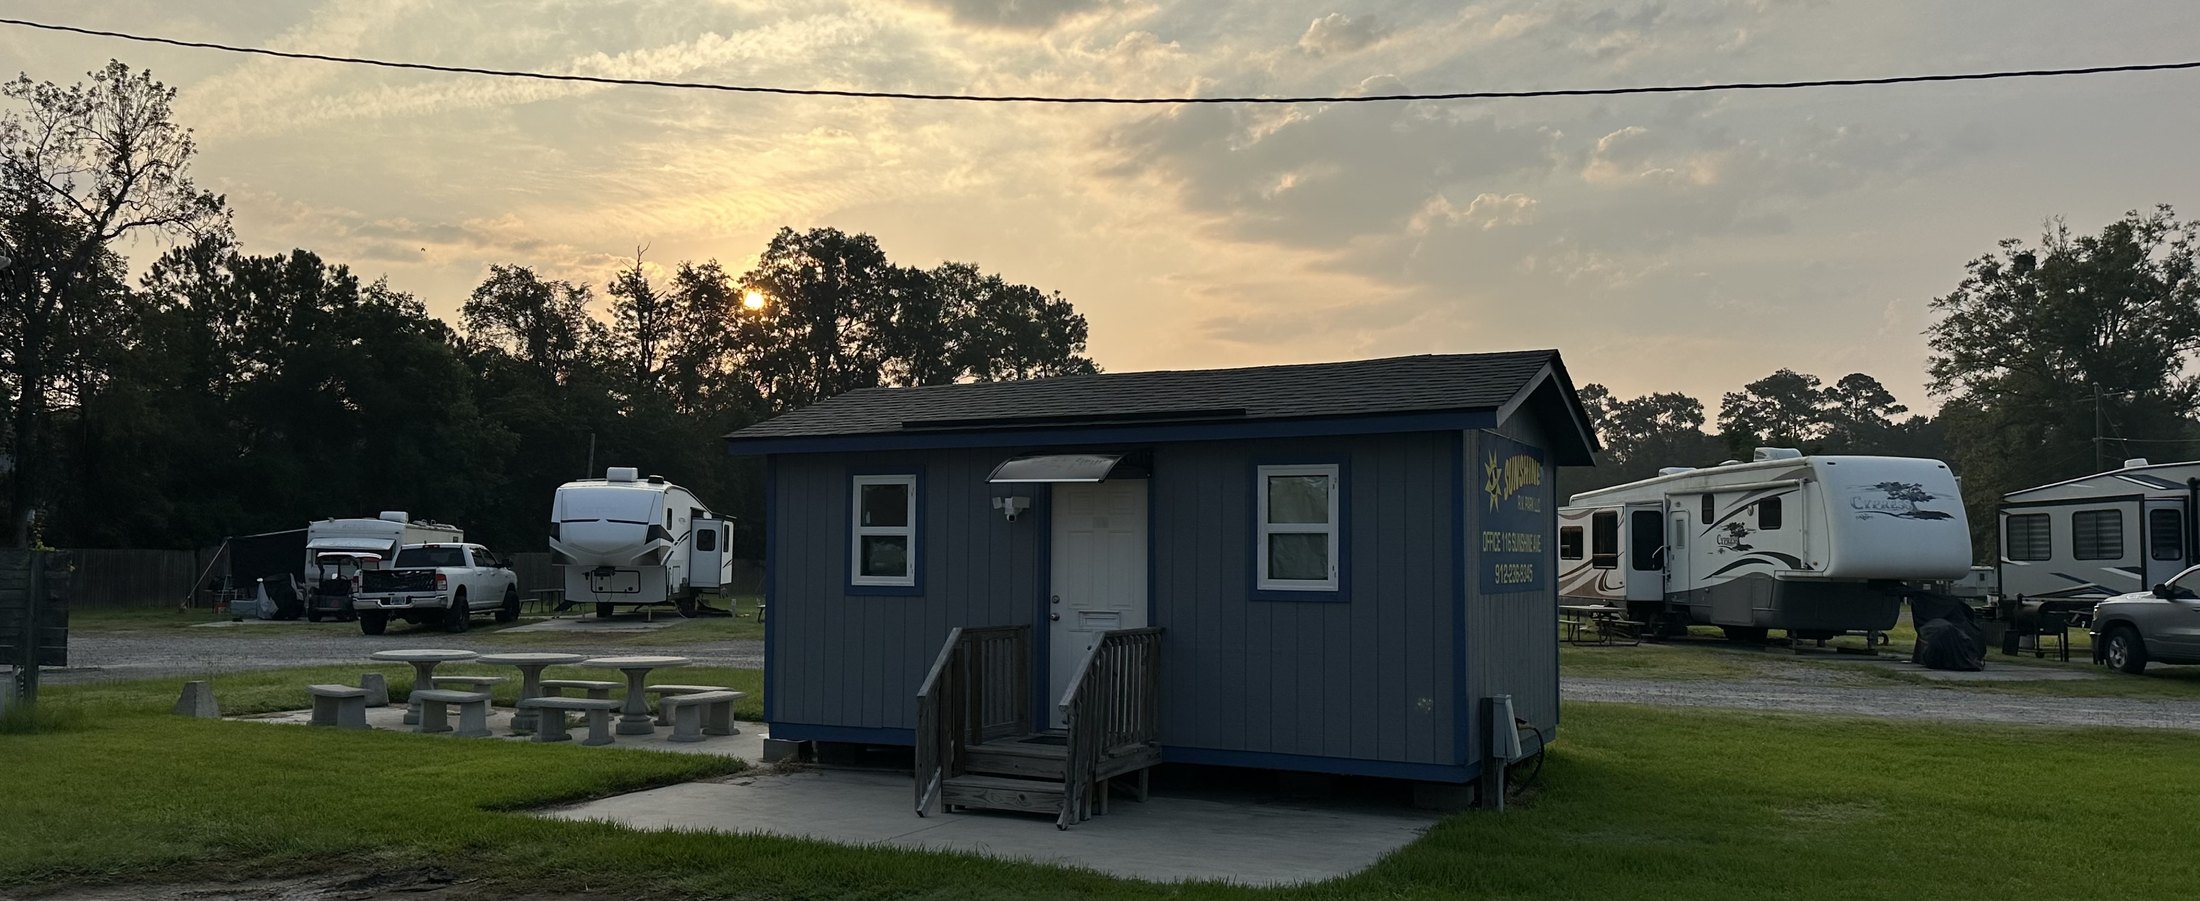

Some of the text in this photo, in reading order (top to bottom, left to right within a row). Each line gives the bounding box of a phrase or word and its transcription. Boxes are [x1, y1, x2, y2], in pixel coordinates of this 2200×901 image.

[1504, 454, 1541, 501] SUNSHINE
[1483, 531, 1501, 552] OFFICE
[1502, 532, 1511, 552] 116
[1512, 532, 1533, 552] SUNSHINE
